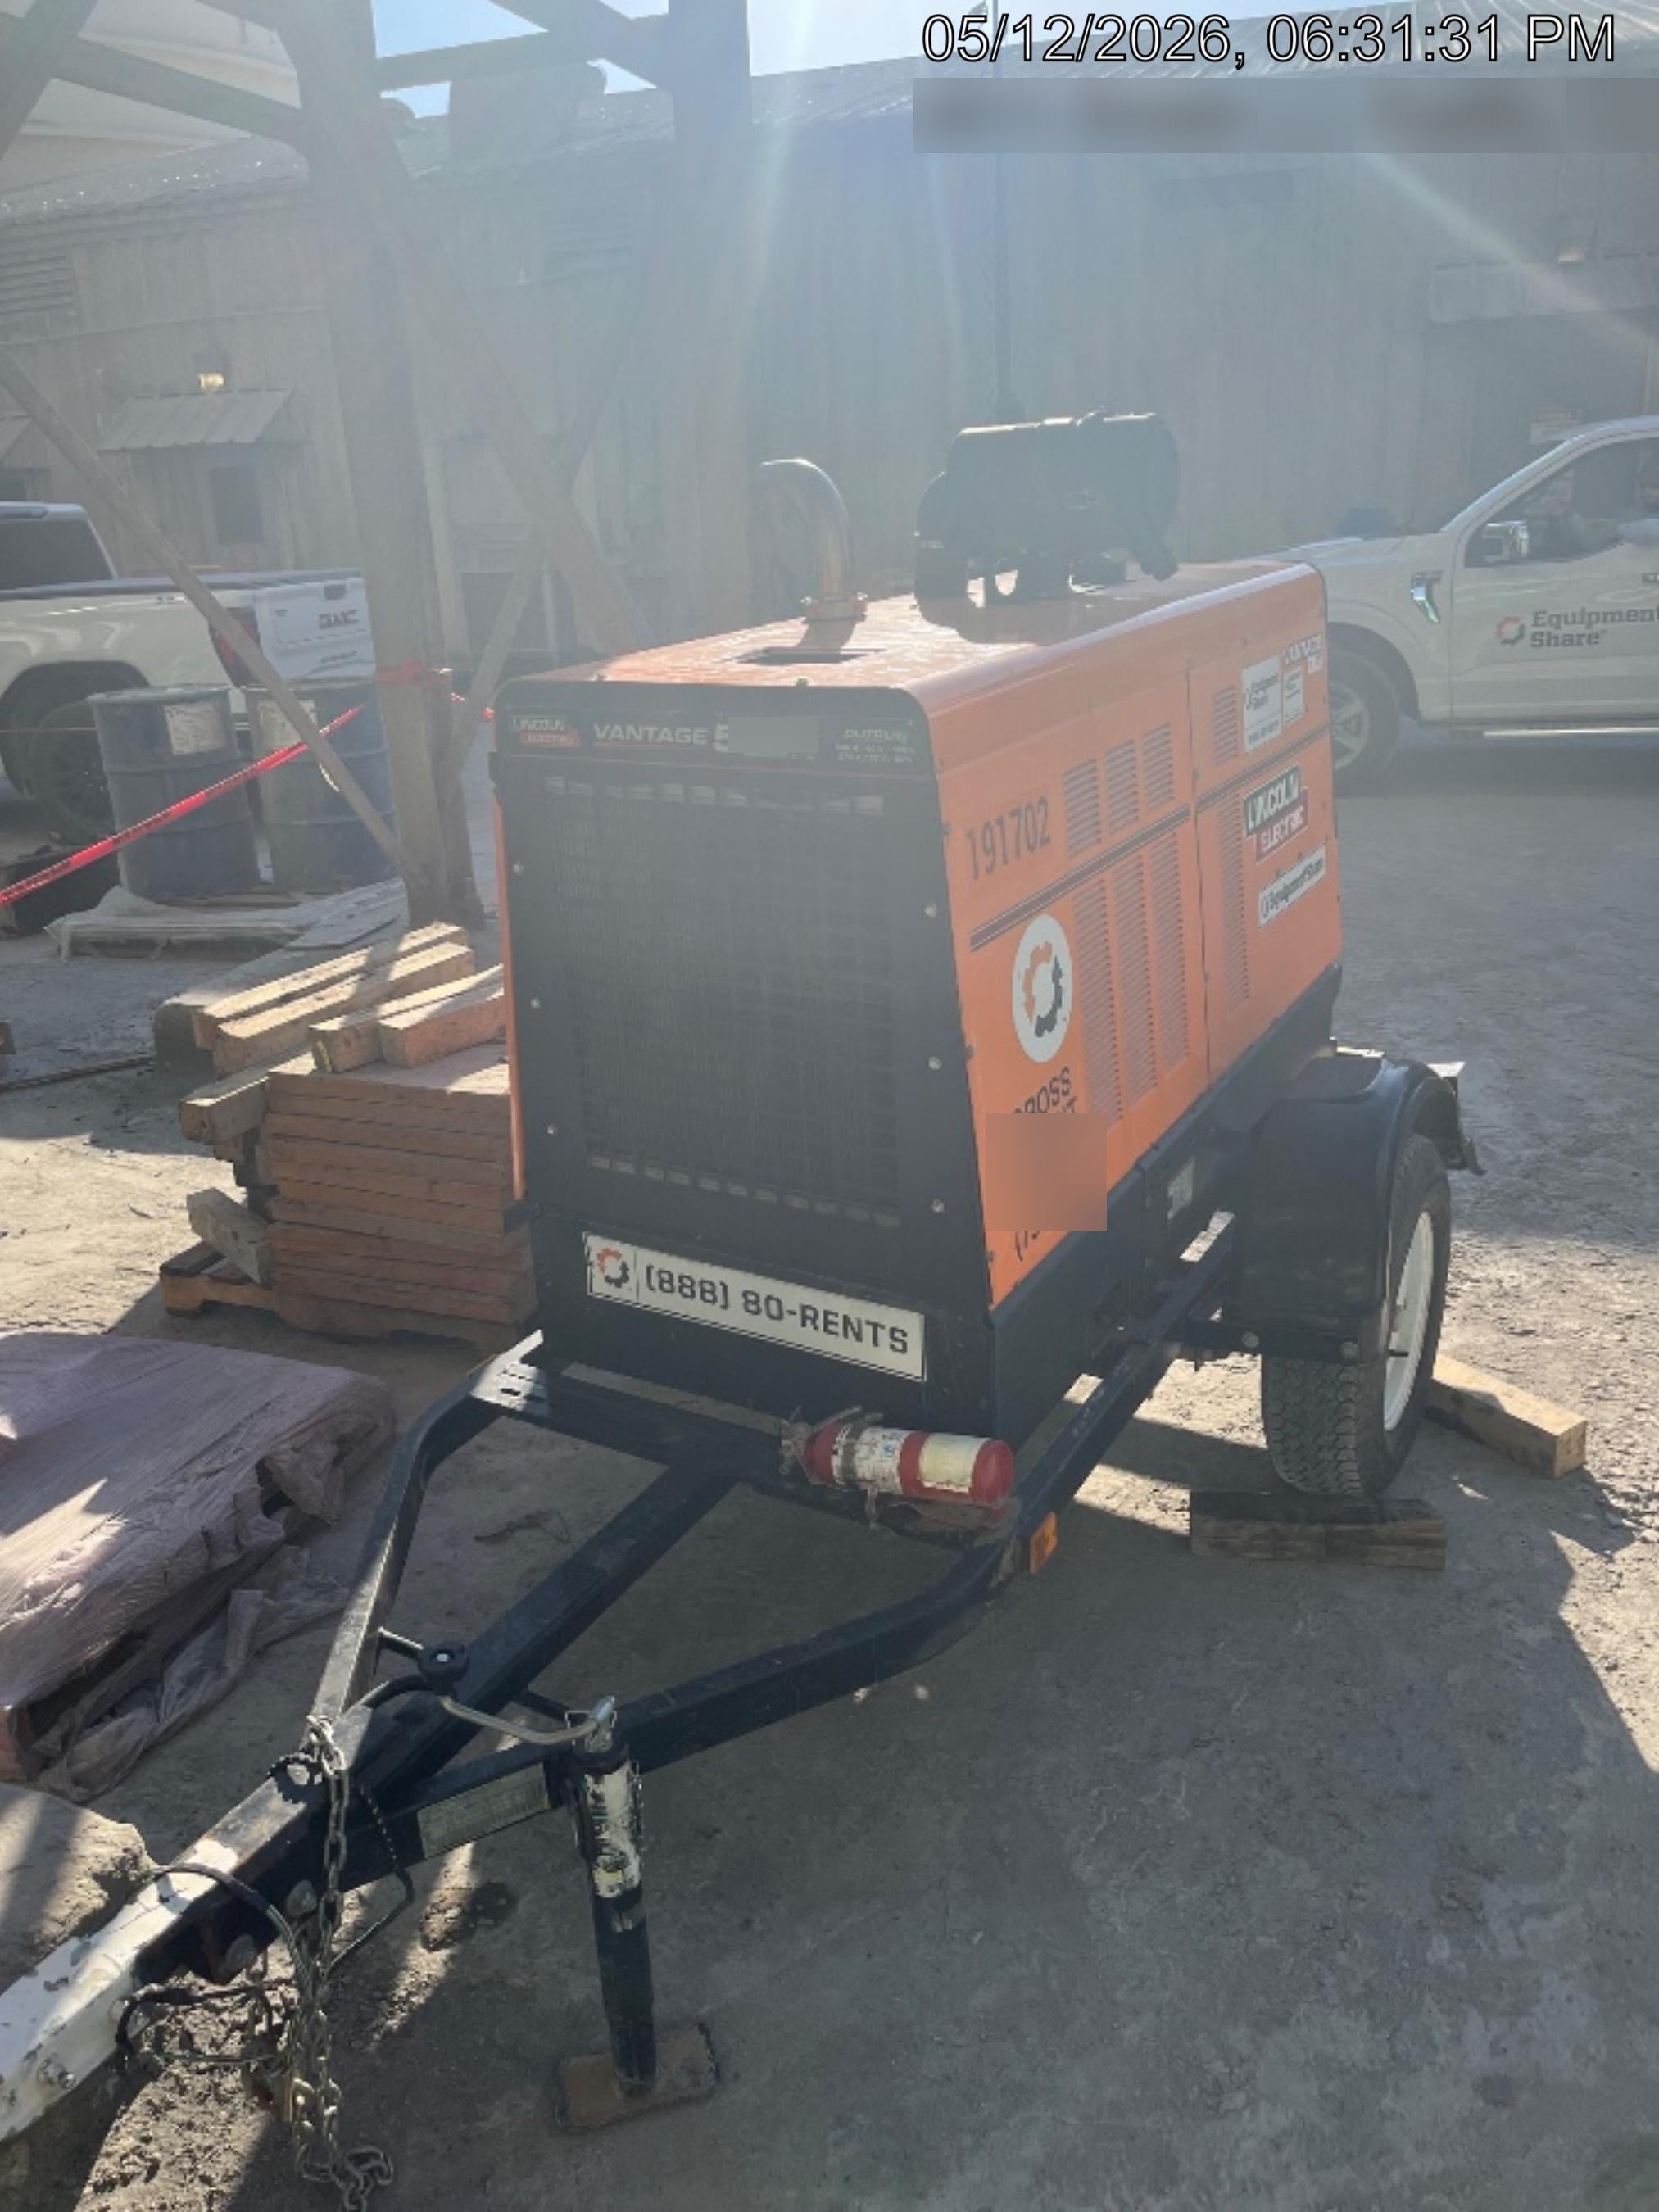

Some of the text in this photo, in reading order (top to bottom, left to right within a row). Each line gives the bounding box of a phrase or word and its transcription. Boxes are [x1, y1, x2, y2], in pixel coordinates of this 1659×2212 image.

[1530, 630, 1599, 648] Share
[593, 723, 708, 746] VANTAGE
[1247, 773, 1299, 831] LINCOLN
[966, 795, 1051, 881] 191702
[646, 1262, 909, 1354] (888) 80-RENTS
